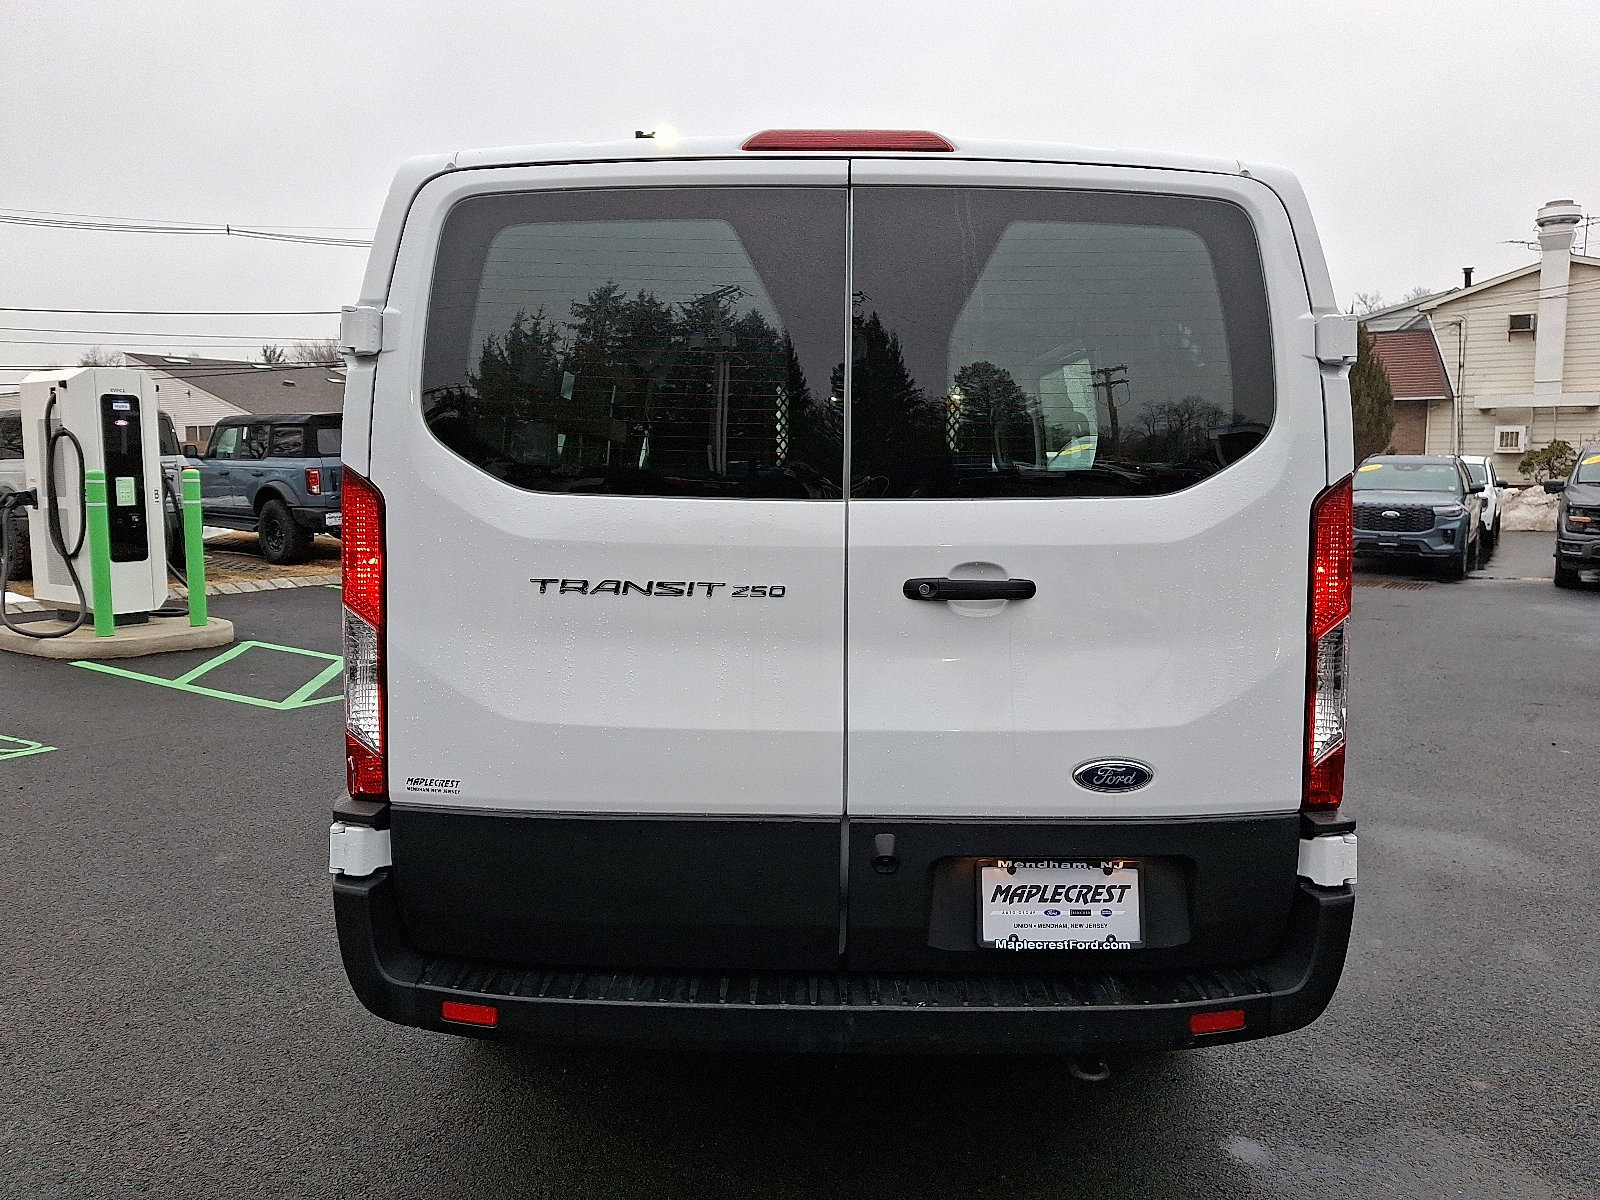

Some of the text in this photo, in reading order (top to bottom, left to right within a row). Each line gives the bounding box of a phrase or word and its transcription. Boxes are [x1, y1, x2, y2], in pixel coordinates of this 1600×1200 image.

[529, 578, 786, 599] TRANSIT 250
[406, 777, 461, 788] MAPLECREST
[1092, 766, 1137, 785] Ford
[997, 860, 1124, 870] Mendham, NJ
[990, 884, 1132, 905] MAPLECREST
[995, 939, 1131, 952] MaplecrestFord.com
